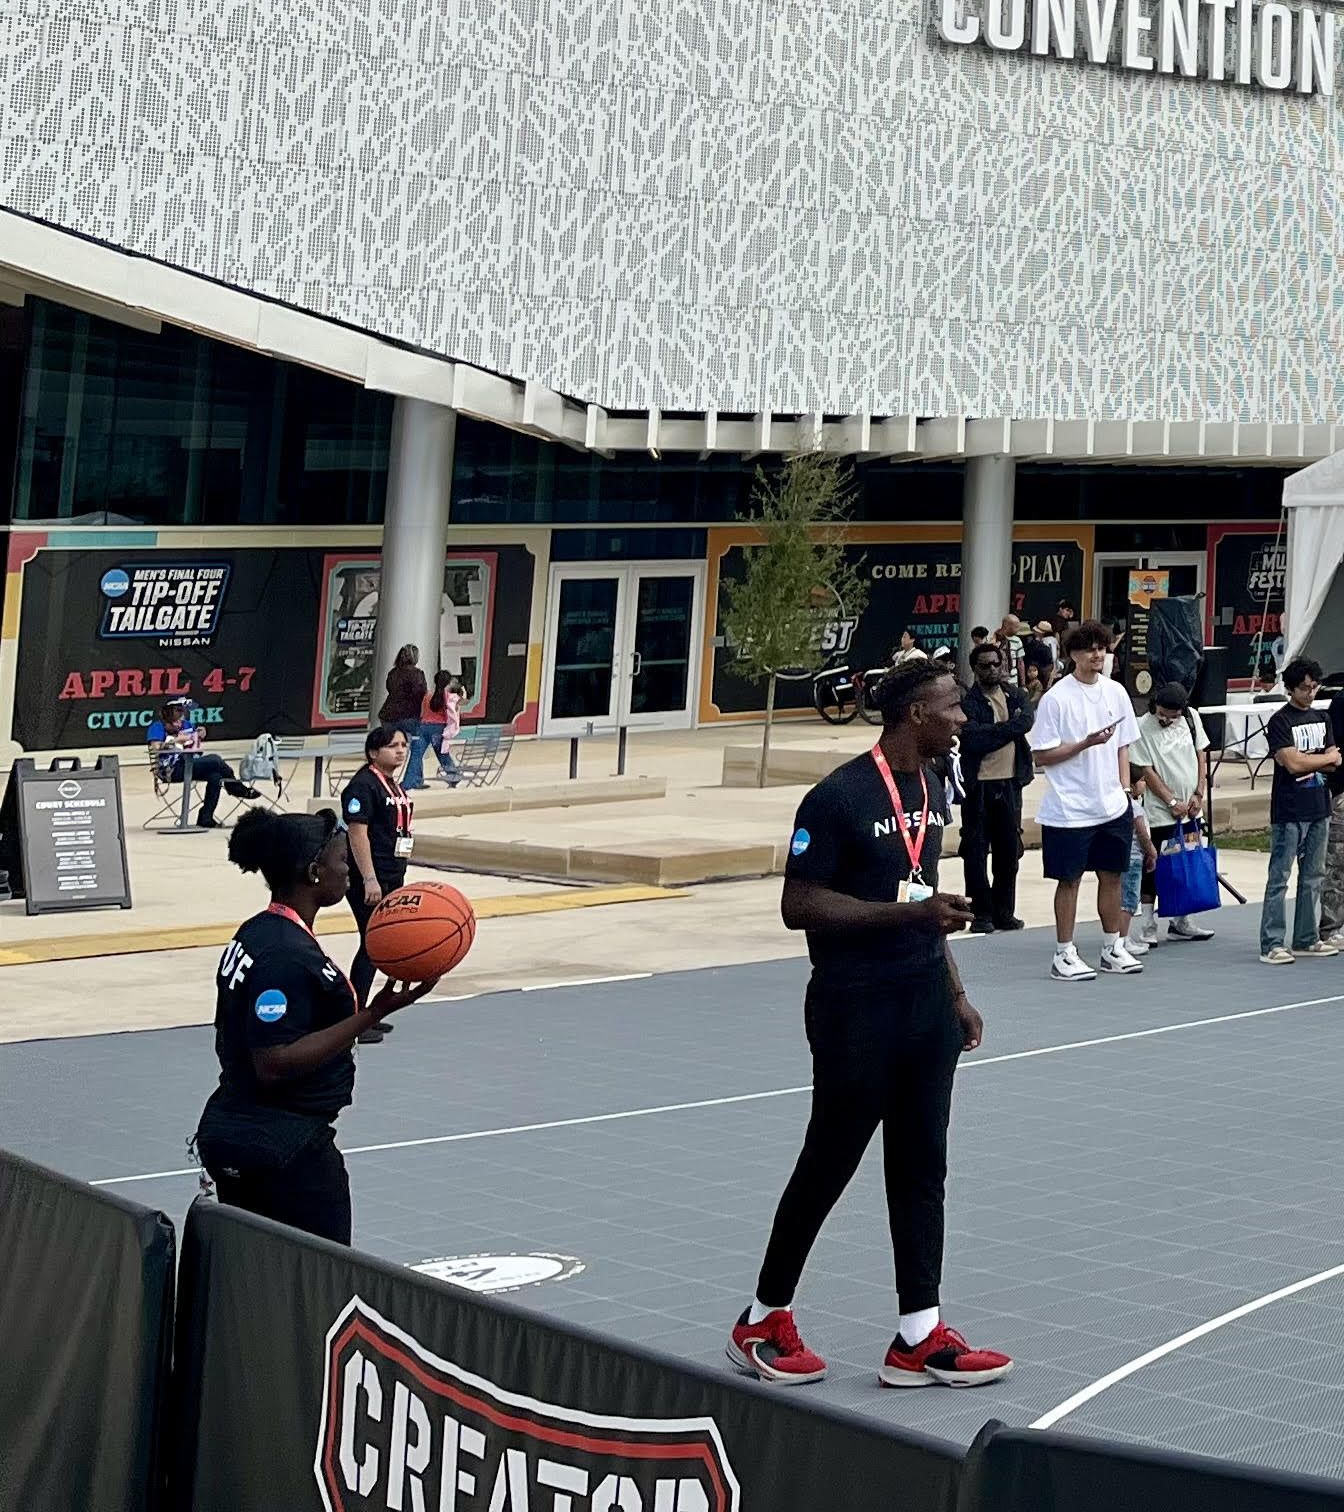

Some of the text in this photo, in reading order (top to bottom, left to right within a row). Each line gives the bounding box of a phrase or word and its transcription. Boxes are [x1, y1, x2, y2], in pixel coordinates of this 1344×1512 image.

[134, 568, 224, 581] MEN'S FINAL FOUR
[871, 564, 928, 579] COME
[1018, 554, 1065, 583] PLAY
[132, 581, 220, 606] TIP-OFF
[912, 593, 961, 614] APR
[109, 605, 215, 632] TAILGATE
[1232, 614, 1281, 634] APR
[159, 638, 211, 647] NISSAN
[58, 667, 256, 699] APRIL 4-7
[87, 707, 224, 729] CIVIC RK
[64, 798, 106, 808] SCHEDULE
[379, 895, 422, 911] NCAA
[256, 1003, 287, 1014] NCAA
